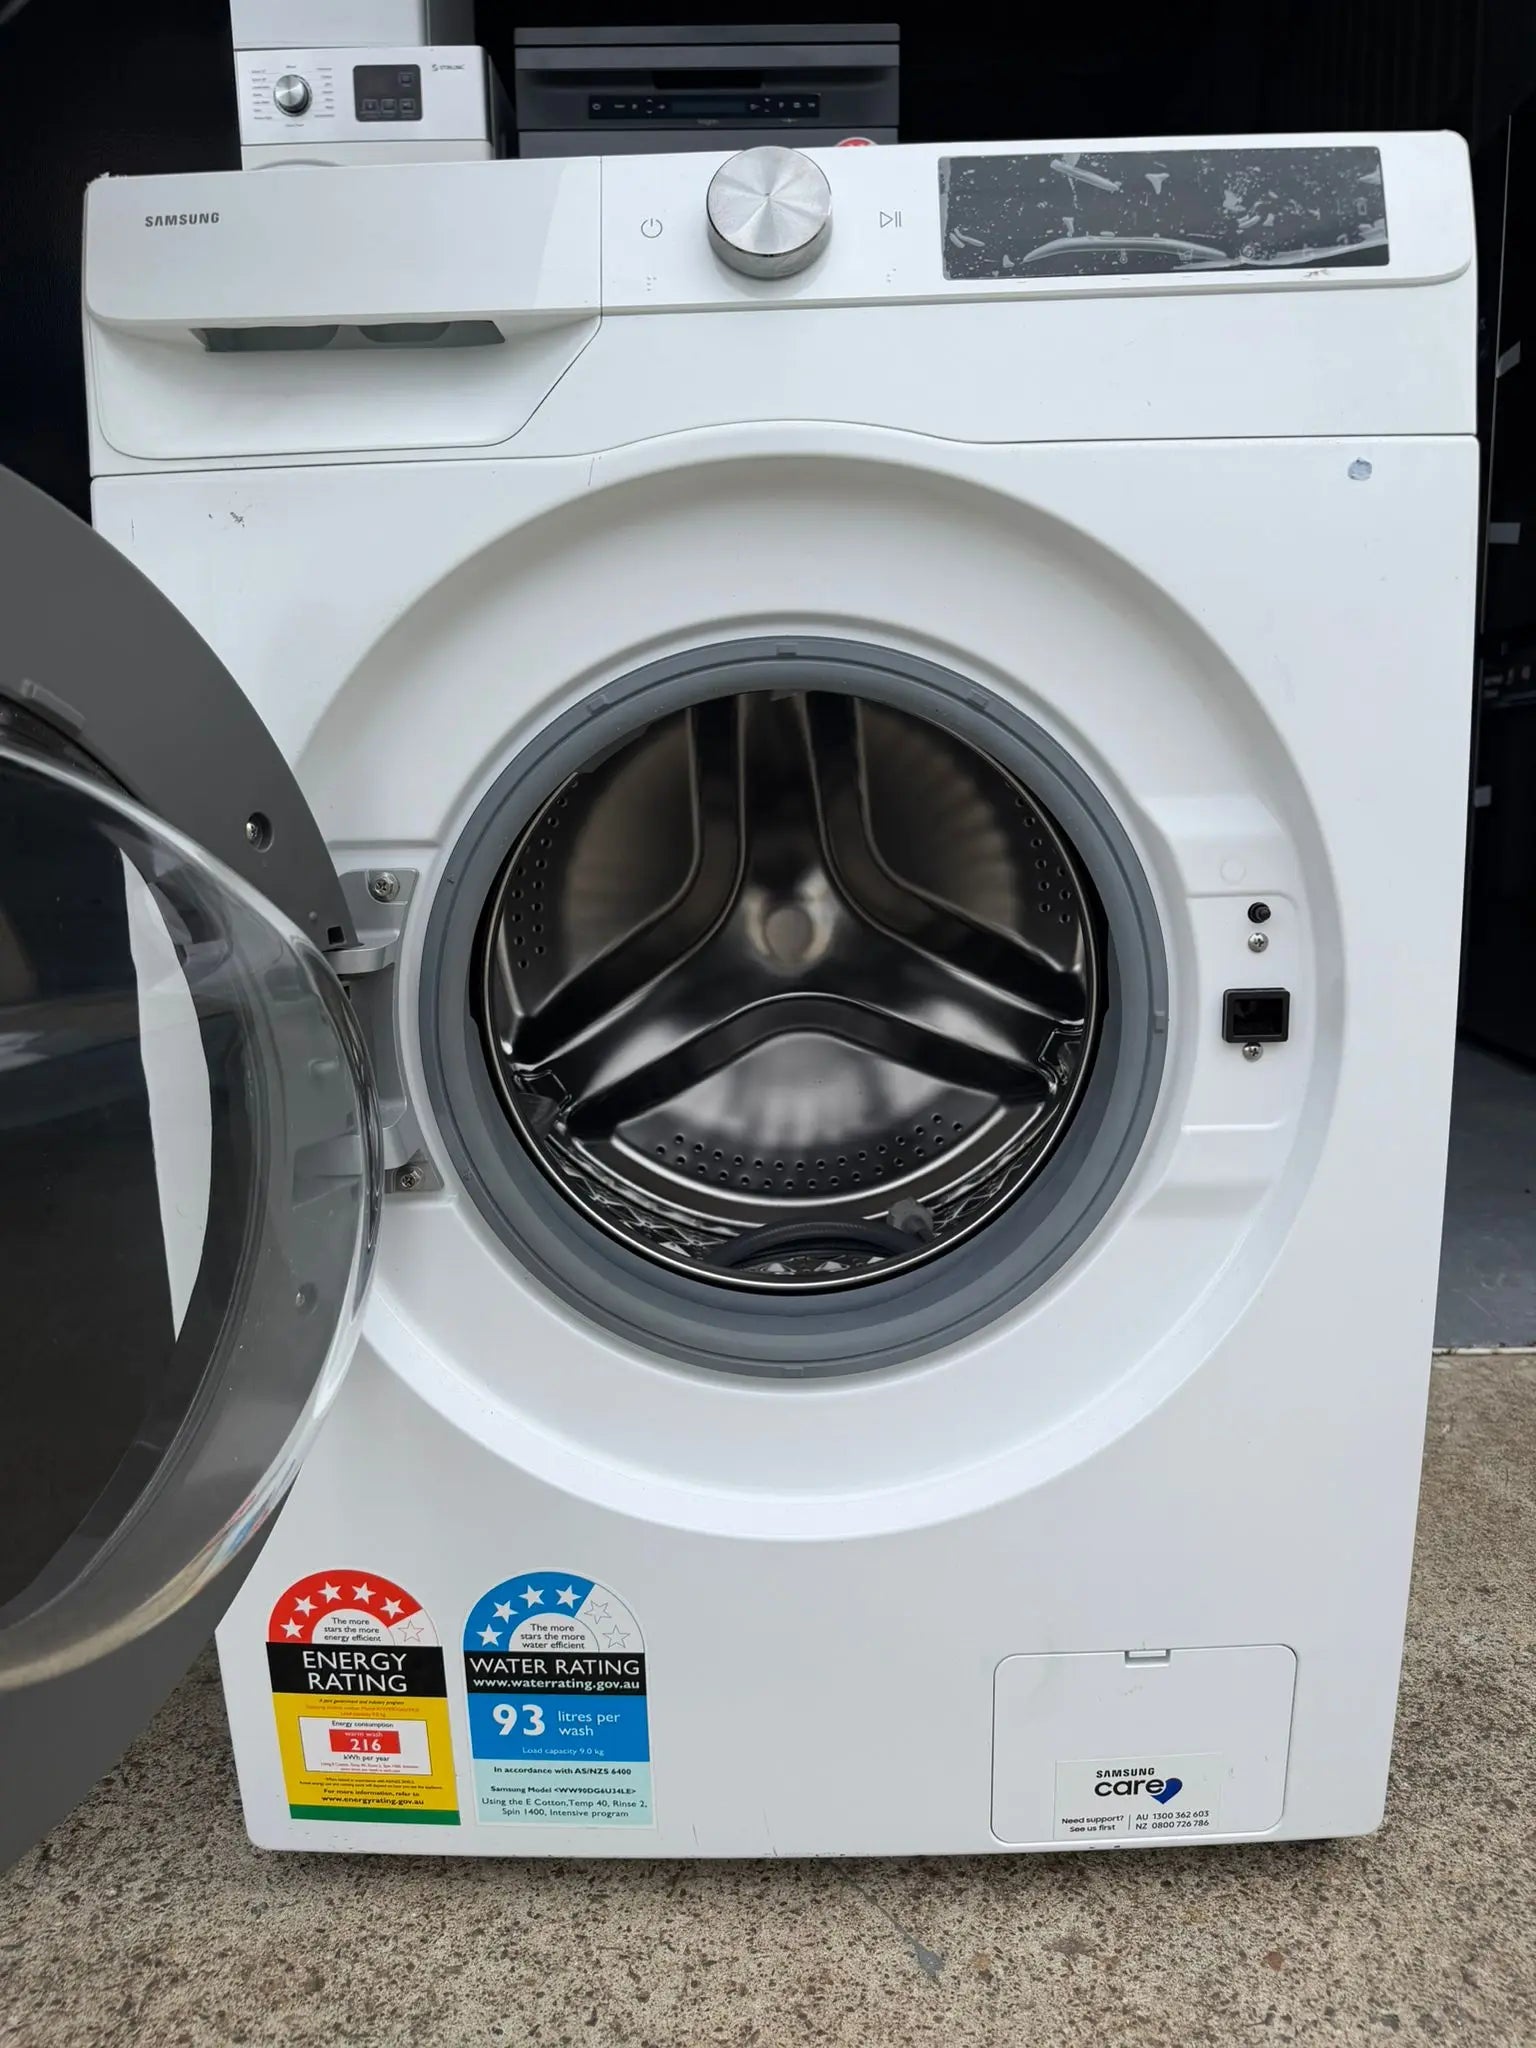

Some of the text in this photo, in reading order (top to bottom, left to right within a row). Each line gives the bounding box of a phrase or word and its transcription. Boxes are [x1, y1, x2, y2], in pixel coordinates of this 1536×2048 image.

[145, 212, 220, 227] SAMSUNG
[331, 1617, 347, 1625] The
[530, 1623, 548, 1631] The
[351, 1634, 381, 1642] efficient
[544, 1632, 559, 1640] the
[550, 1641, 585, 1649] efficient
[302, 1650, 407, 1671] ENERGY
[469, 1657, 640, 1675] WATER RATING
[307, 1672, 408, 1692] RATING
[473, 1678, 640, 1691] www.waterrating.gov.au
[492, 1703, 546, 1736] 93
[557, 1710, 621, 1725] litres per
[331, 1720, 352, 1728] Energy
[558, 1725, 594, 1736] wash
[350, 1738, 382, 1752] 216
[545, 1747, 577, 1756] capacity
[594, 1748, 605, 1756] kg
[575, 1767, 609, 1775] AS/NZS
[1096, 1767, 1155, 1779] SAMSUNG
[490, 1785, 526, 1793] Samsung
[1094, 1778, 1165, 1797] care
[321, 1796, 424, 1805] www.energyrating.gov.au
[482, 1797, 506, 1807] Using
[613, 1799, 637, 1807] Rinse
[502, 1807, 521, 1816] Spin
[550, 1808, 588, 1816] Intensive
[591, 1811, 629, 1819] program
[1136, 1810, 1209, 1821] AU 1300 362 603
[1061, 1815, 1125, 1825] Need support?
[1151, 1821, 1174, 1829] 0800
[1176, 1820, 1192, 1828] 726
[1194, 1819, 1210, 1827] 786
[1099, 1824, 1116, 1832] first
